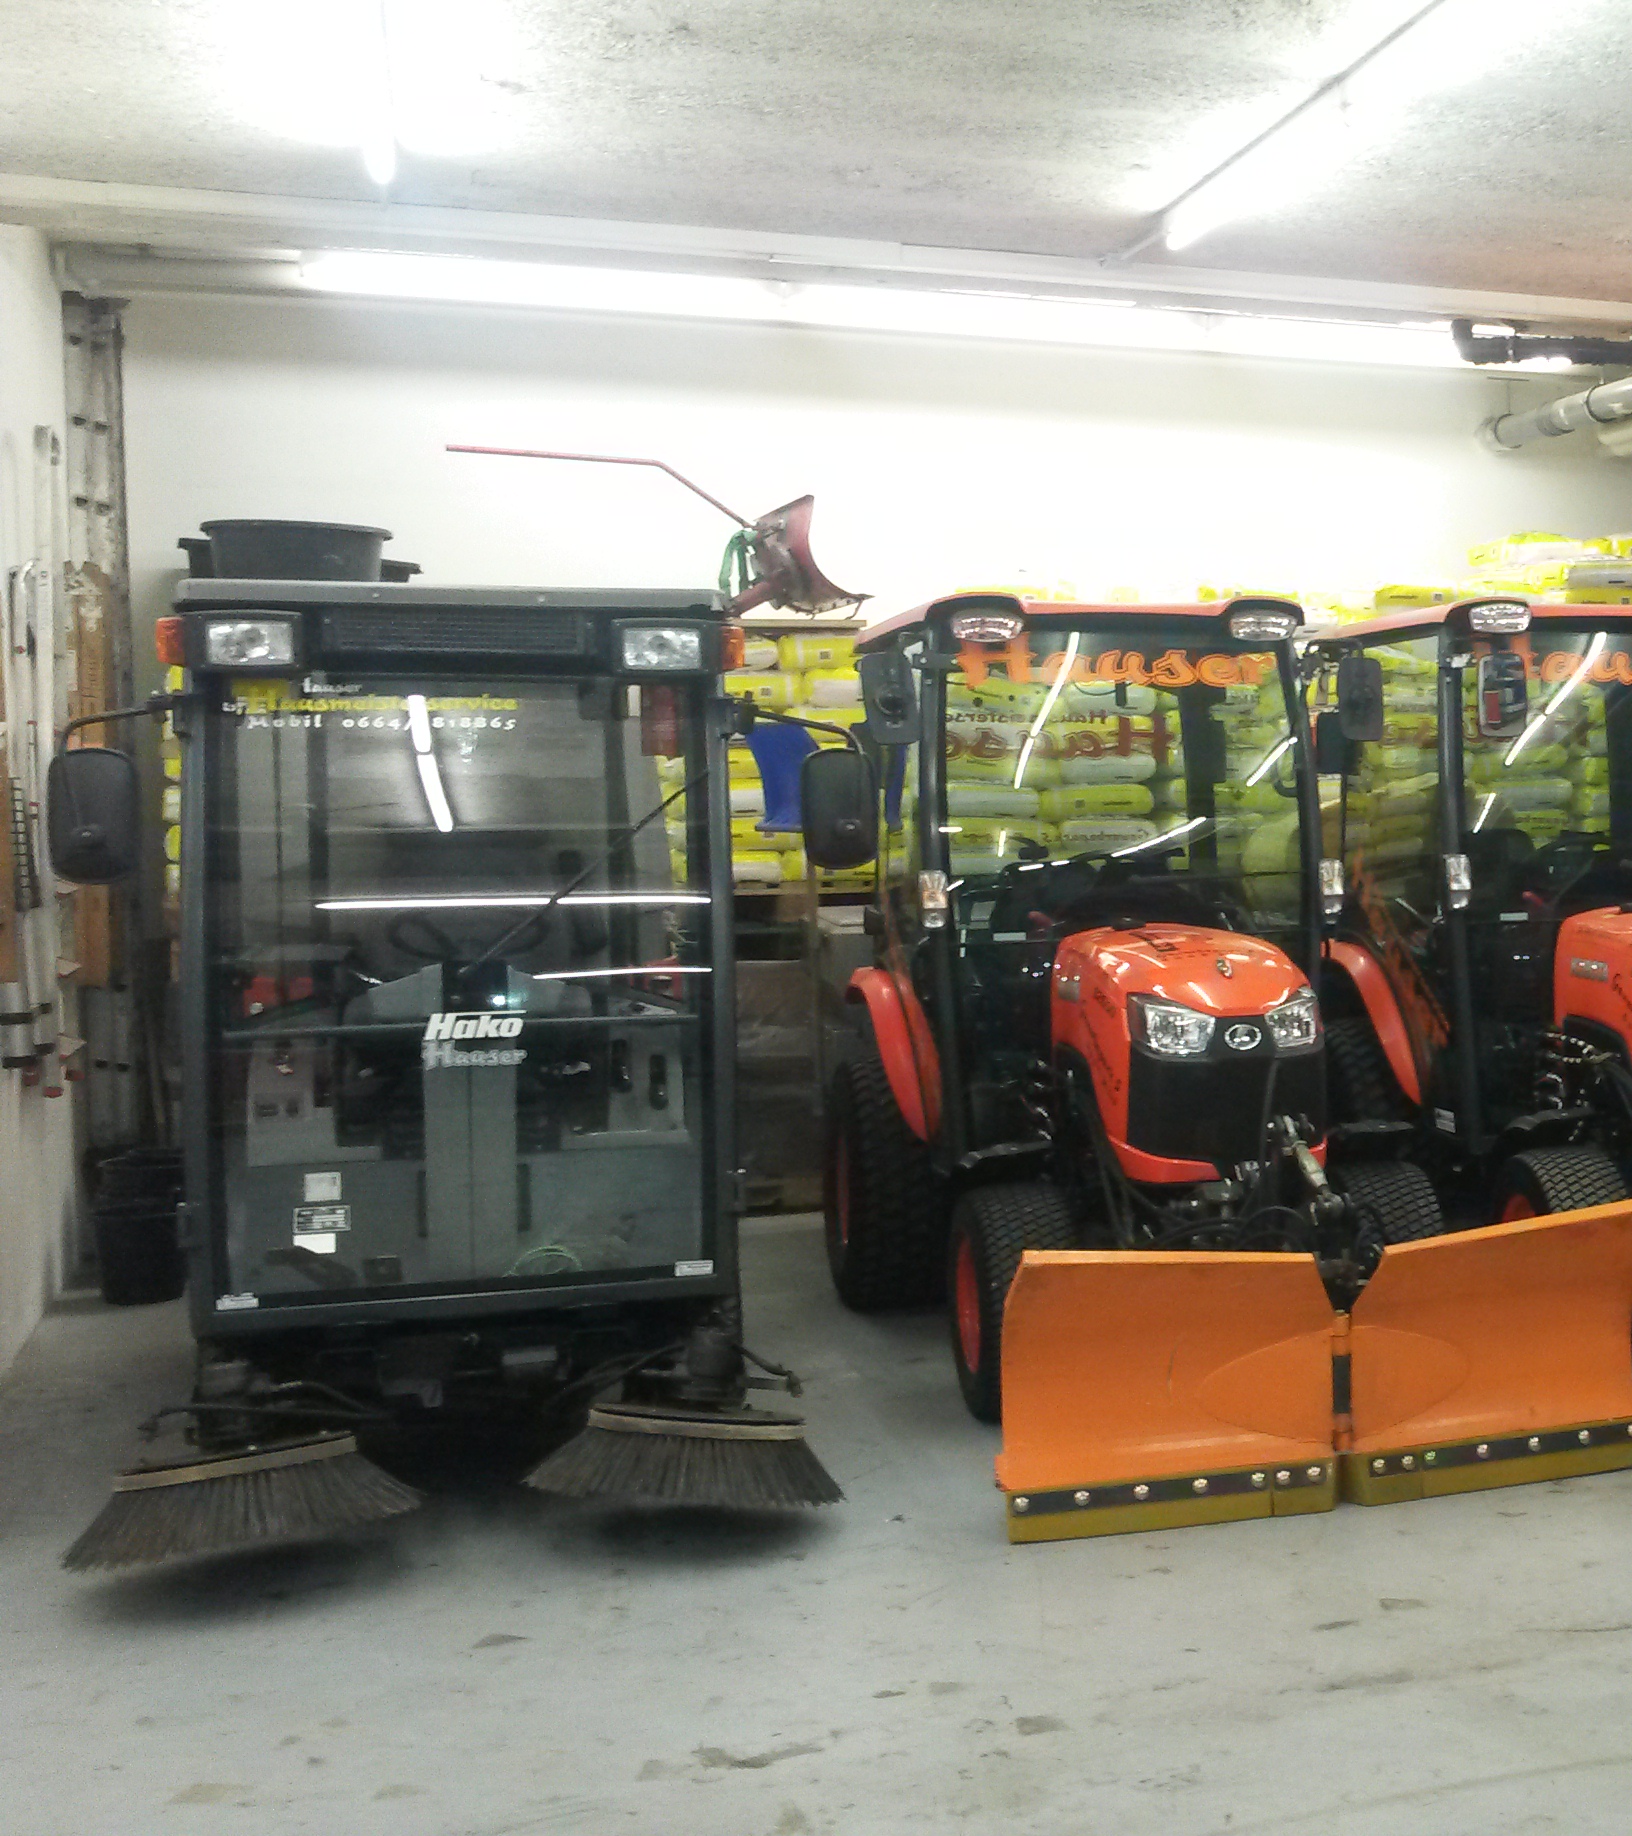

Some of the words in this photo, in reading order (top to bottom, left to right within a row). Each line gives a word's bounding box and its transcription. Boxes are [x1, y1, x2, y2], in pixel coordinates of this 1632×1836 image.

[955, 632, 1277, 690] Hauser
[246, 714, 323, 730] Mobil
[342, 716, 517, 732] 0664/818865
[424, 1010, 527, 1040] Hako
[422, 1039, 529, 1071] Hauser
